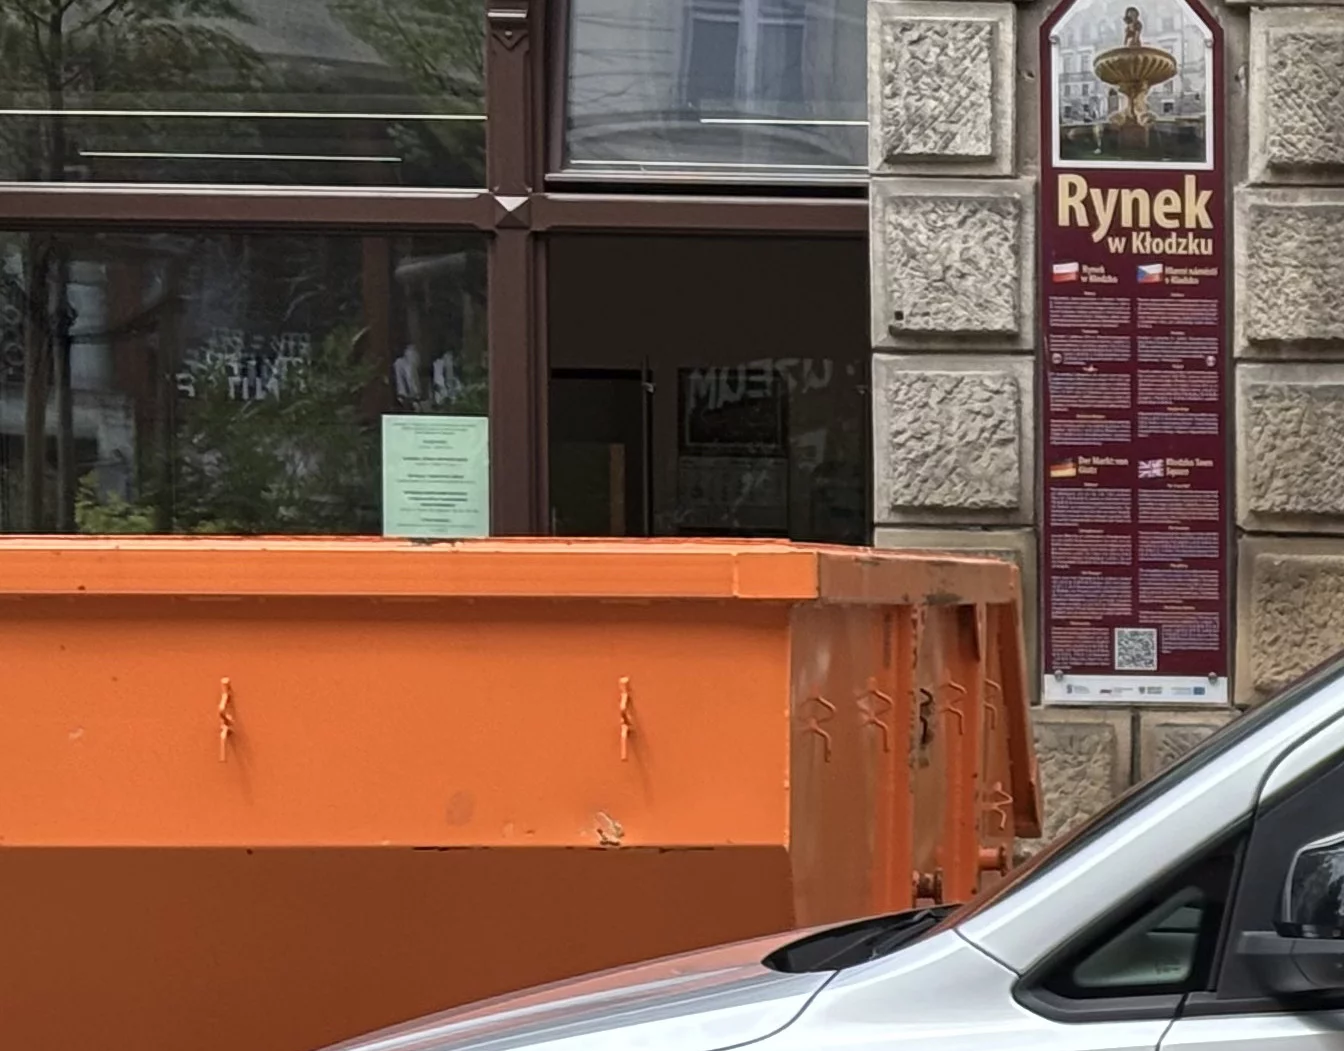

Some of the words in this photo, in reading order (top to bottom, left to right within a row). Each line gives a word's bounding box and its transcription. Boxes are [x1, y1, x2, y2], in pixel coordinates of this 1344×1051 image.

[1057, 173, 1214, 243] Rynek
[1108, 237, 1127, 254] w
[1132, 231, 1213, 255] Kłodzku
